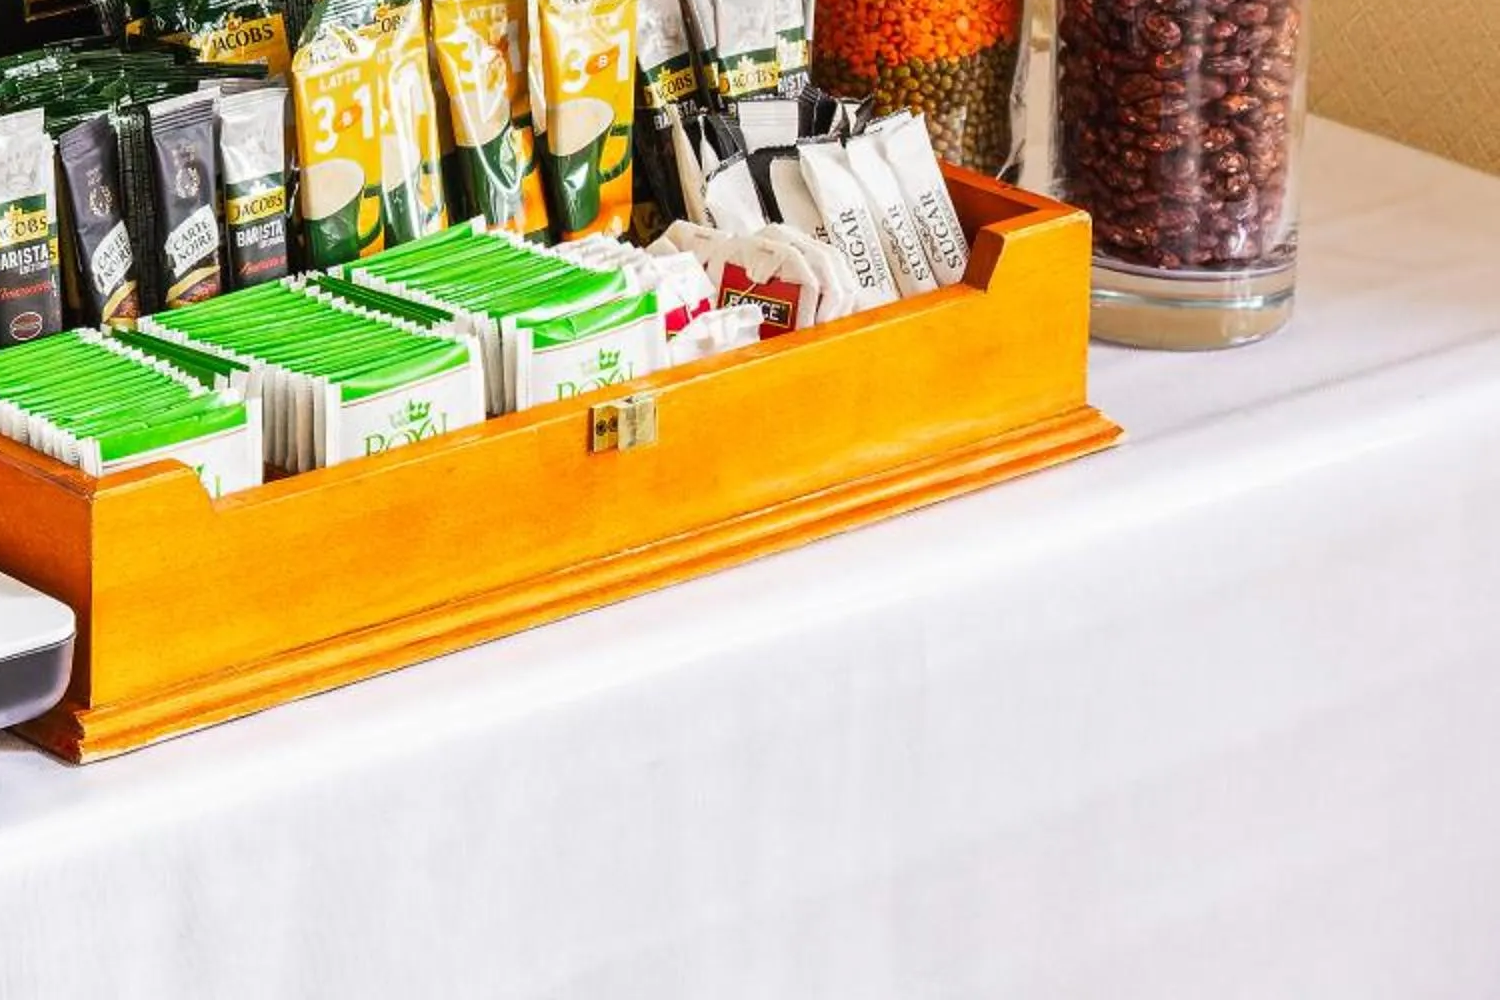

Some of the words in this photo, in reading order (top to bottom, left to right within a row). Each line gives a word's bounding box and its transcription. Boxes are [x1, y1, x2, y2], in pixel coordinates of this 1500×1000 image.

[211, 22, 275, 52] JACOBS
[609, 30, 630, 82] 1
[311, 96, 339, 153] 3
[352, 83, 375, 140] 1
[230, 195, 283, 222] JACOBS
[173, 220, 211, 252] CARTE
[177, 231, 215, 261] NOIRE
[236, 219, 284, 248] BARISTA
[840, 208, 876, 289] SUGAR
[887, 204, 929, 281] SUGAR
[920, 190, 963, 270] SUGAR
